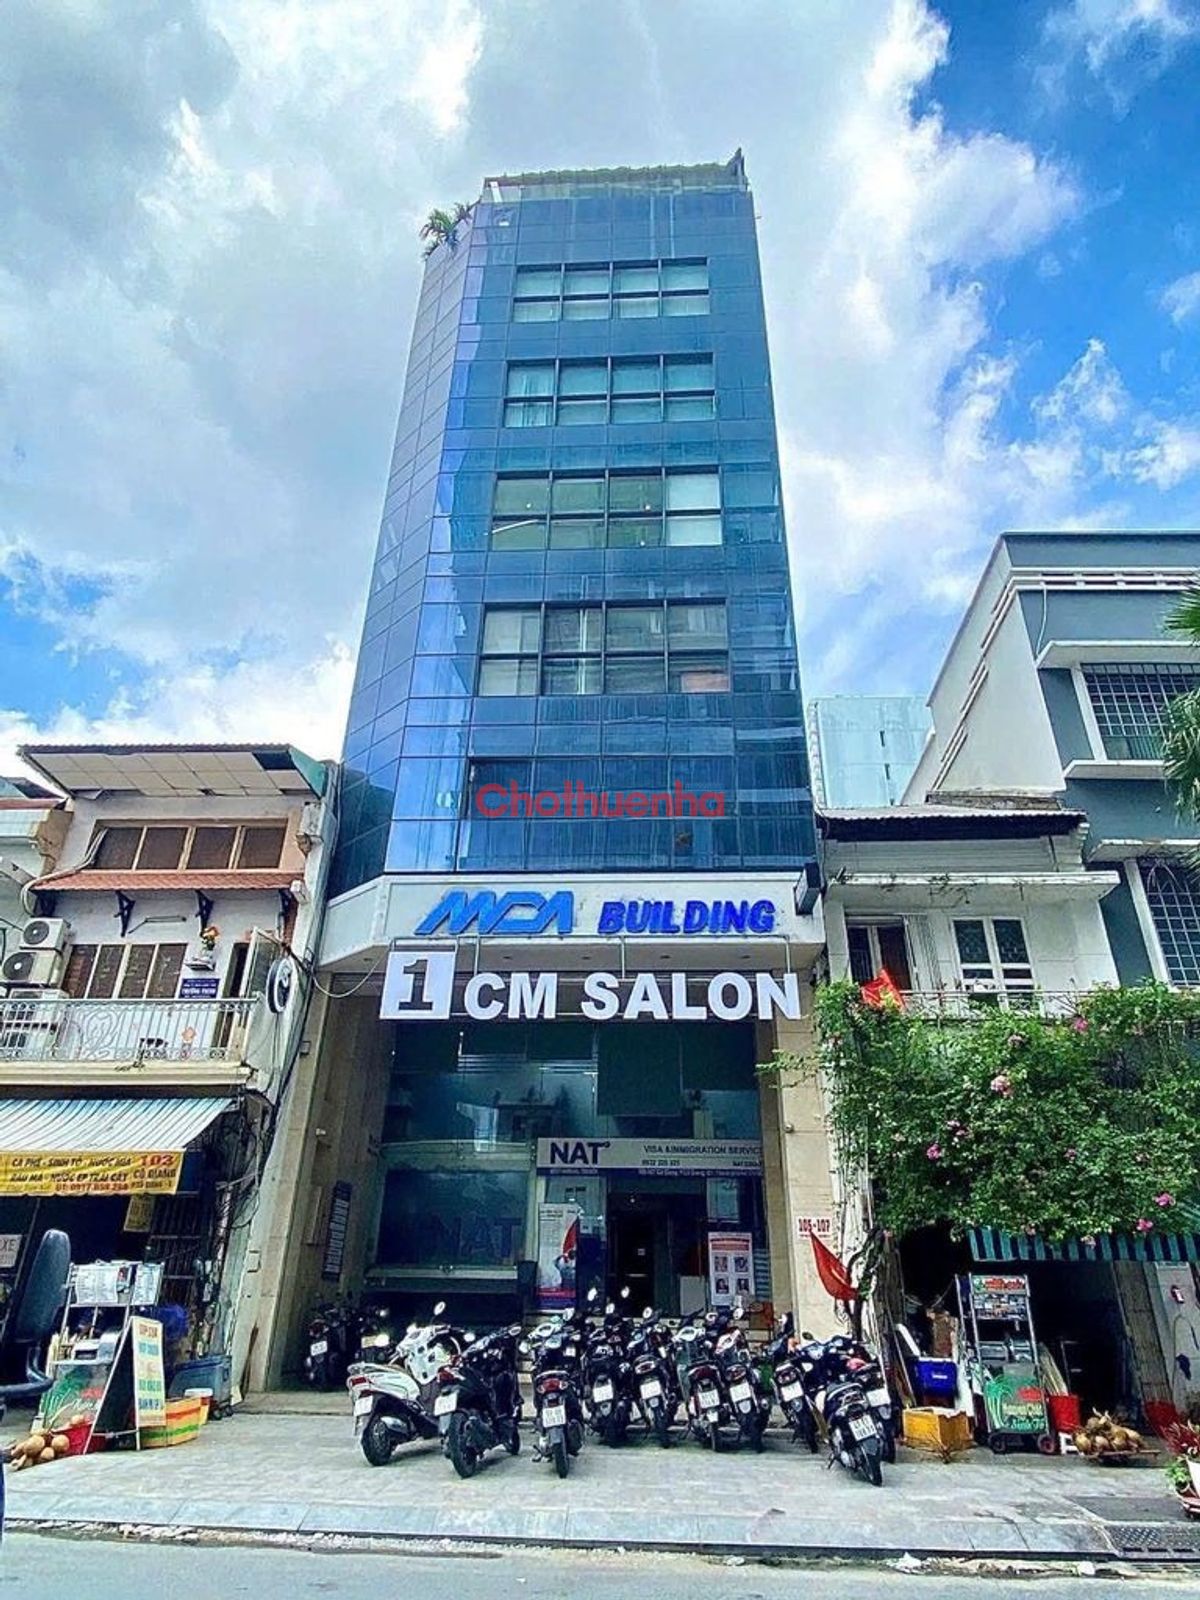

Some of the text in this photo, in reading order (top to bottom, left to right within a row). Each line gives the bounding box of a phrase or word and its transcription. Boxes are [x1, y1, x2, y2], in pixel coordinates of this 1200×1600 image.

[597, 900, 776, 934] BUILDING
[398, 959, 800, 1021] 1 CM SALON
